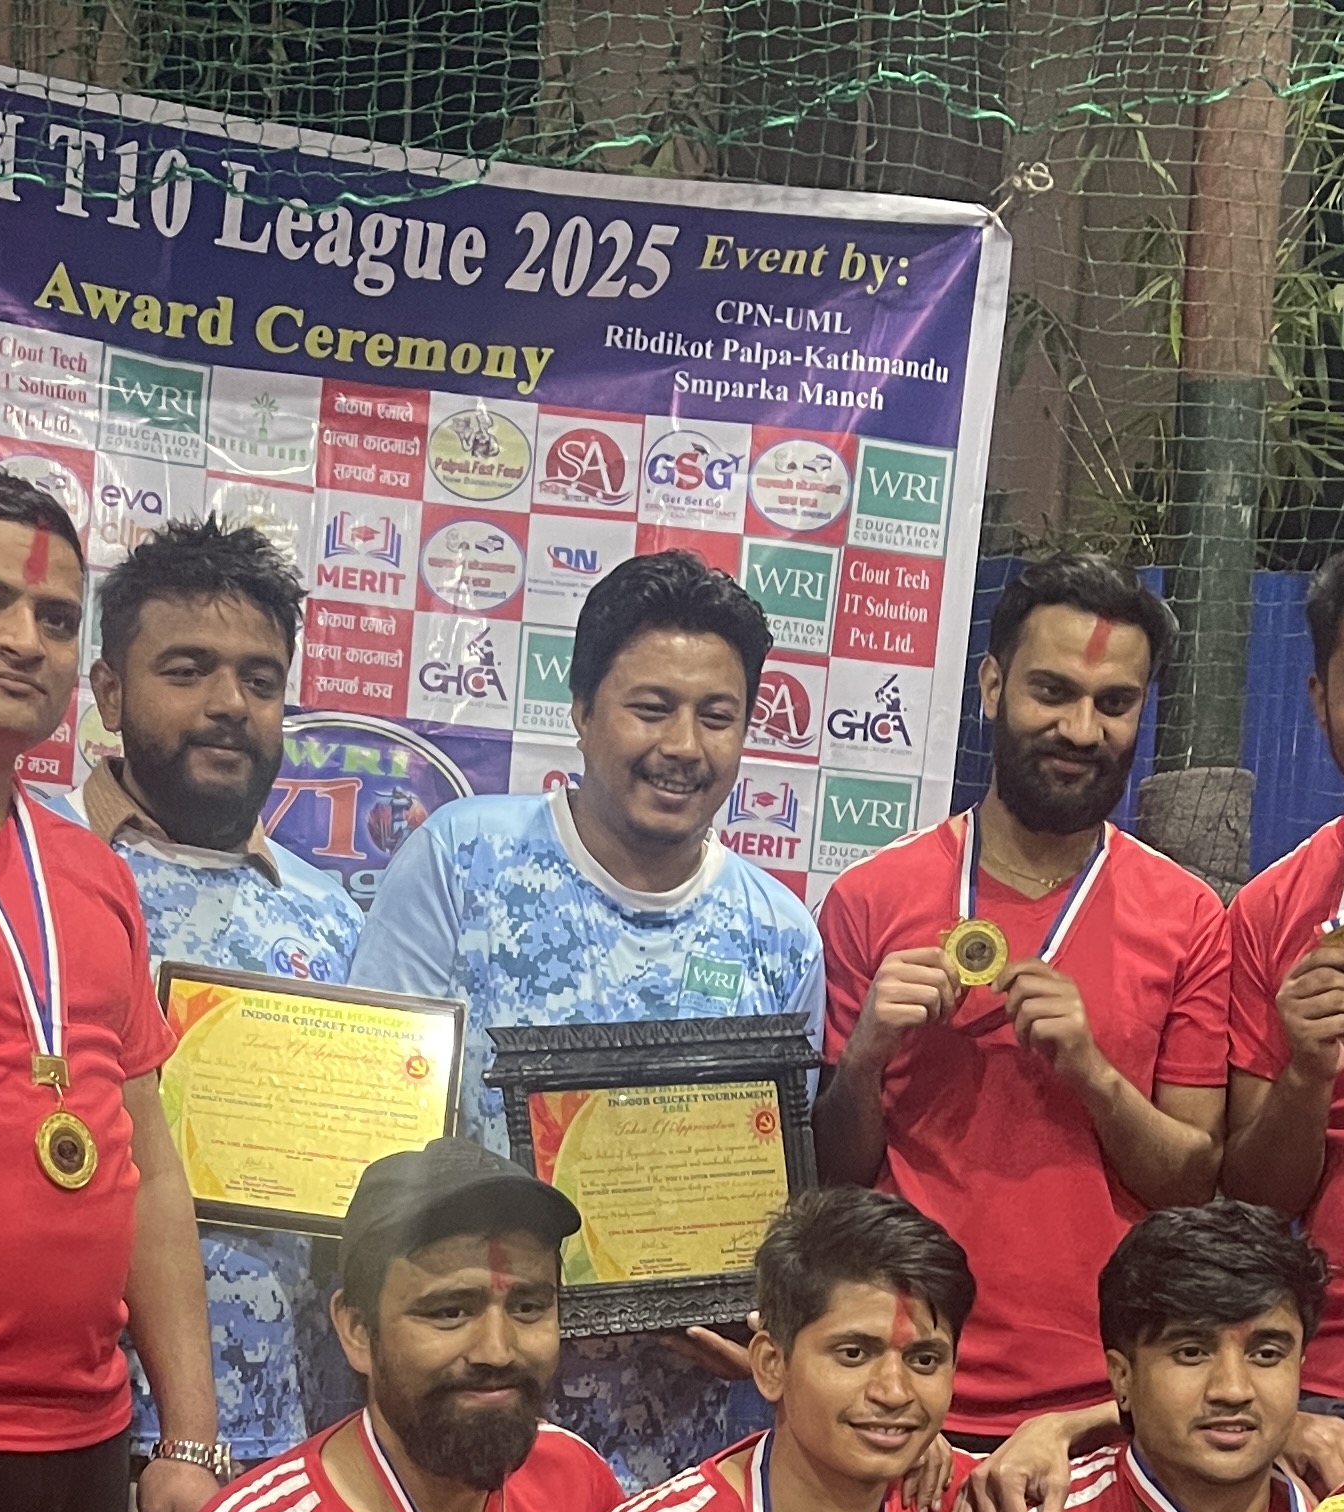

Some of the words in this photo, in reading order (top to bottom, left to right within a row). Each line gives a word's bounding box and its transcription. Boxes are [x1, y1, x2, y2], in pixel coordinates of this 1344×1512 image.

[49, 122, 194, 238] T10
[214, 158, 487, 297] League
[505, 210, 680, 298] 2025
[698, 234, 826, 277] Event
[838, 234, 910, 290] by:
[34, 261, 234, 347] Award
[256, 305, 554, 395] Ceremony
[715, 300, 852, 335] CPN-UML
[50, 347, 88, 374] Tech
[604, 325, 714, 361] Ribdikot
[722, 340, 950, 385] Palpa-Kathmandu
[19, 376, 88, 404] Solution
[113, 376, 196, 417] WRI
[673, 371, 789, 404] Smparka
[797, 382, 885, 411] Manch
[108, 424, 201, 449] EDUCATION
[472, 461, 494, 477] Fast
[648, 452, 732, 490] GSG
[101, 484, 162, 515] eva
[662, 493, 682, 504] Get
[866, 466, 941, 505] WRI
[853, 530, 939, 549] CONSULTANCY
[856, 518, 940, 540] EDUCATION
[317, 563, 406, 595] MERIT
[753, 563, 827, 601] WRI
[849, 560, 891, 584] Clout
[895, 566, 930, 591] Tech
[843, 593, 862, 614] IT
[864, 596, 929, 623] Solution
[849, 627, 879, 650] Pvt.
[884, 632, 915, 654] Ltd.
[419, 661, 508, 701] GHCA
[522, 715, 570, 729] CONSUL
[827, 708, 913, 747] GHCA
[829, 795, 907, 830] WRI
[720, 829, 802, 860] MERIT
[693, 966, 737, 990] WRI
[241, 1009, 290, 1024] INDOOR
[293, 1016, 346, 1032] CRICKET
[608, 1097, 651, 1107] INDOOR
[653, 1094, 699, 1105] CRICKET
[702, 1090, 775, 1102] TOURNAMENT
